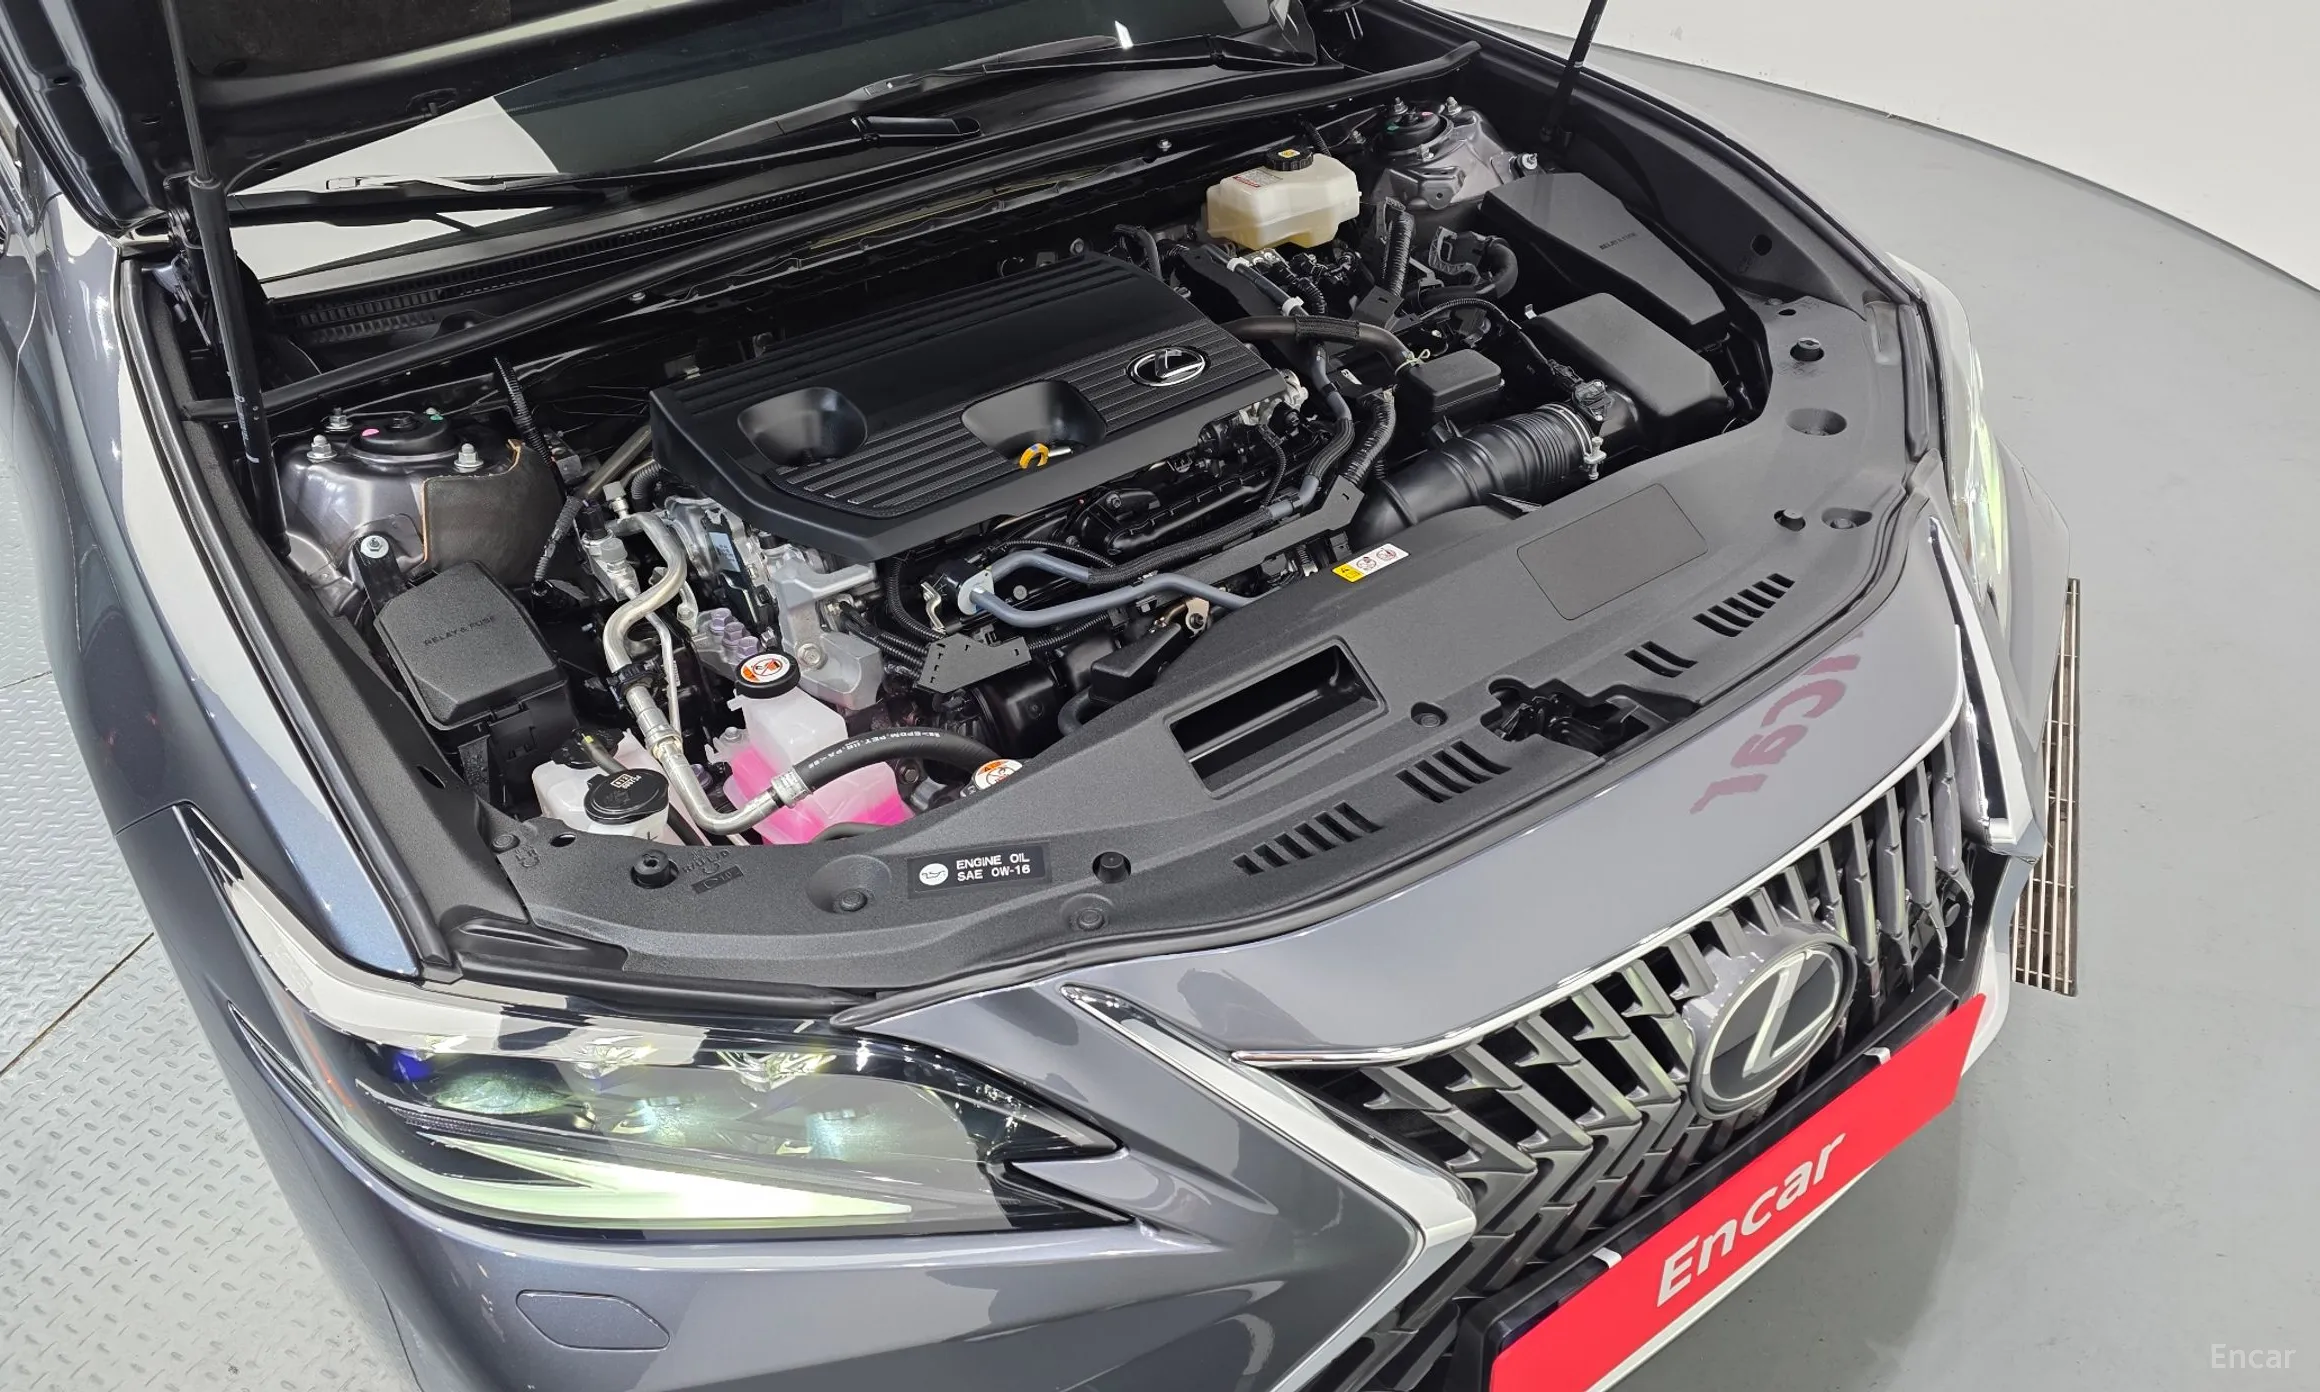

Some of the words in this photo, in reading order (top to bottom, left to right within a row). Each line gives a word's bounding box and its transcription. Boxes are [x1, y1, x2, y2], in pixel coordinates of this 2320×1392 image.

[424, 629, 458, 646] RELAY
[956, 855, 1003, 870] ENGINE
[1009, 853, 1030, 864] OIL
[957, 869, 983, 882] SAE
[991, 864, 1031, 878] 0W-16
[1657, 1132, 1847, 1308] Encar
